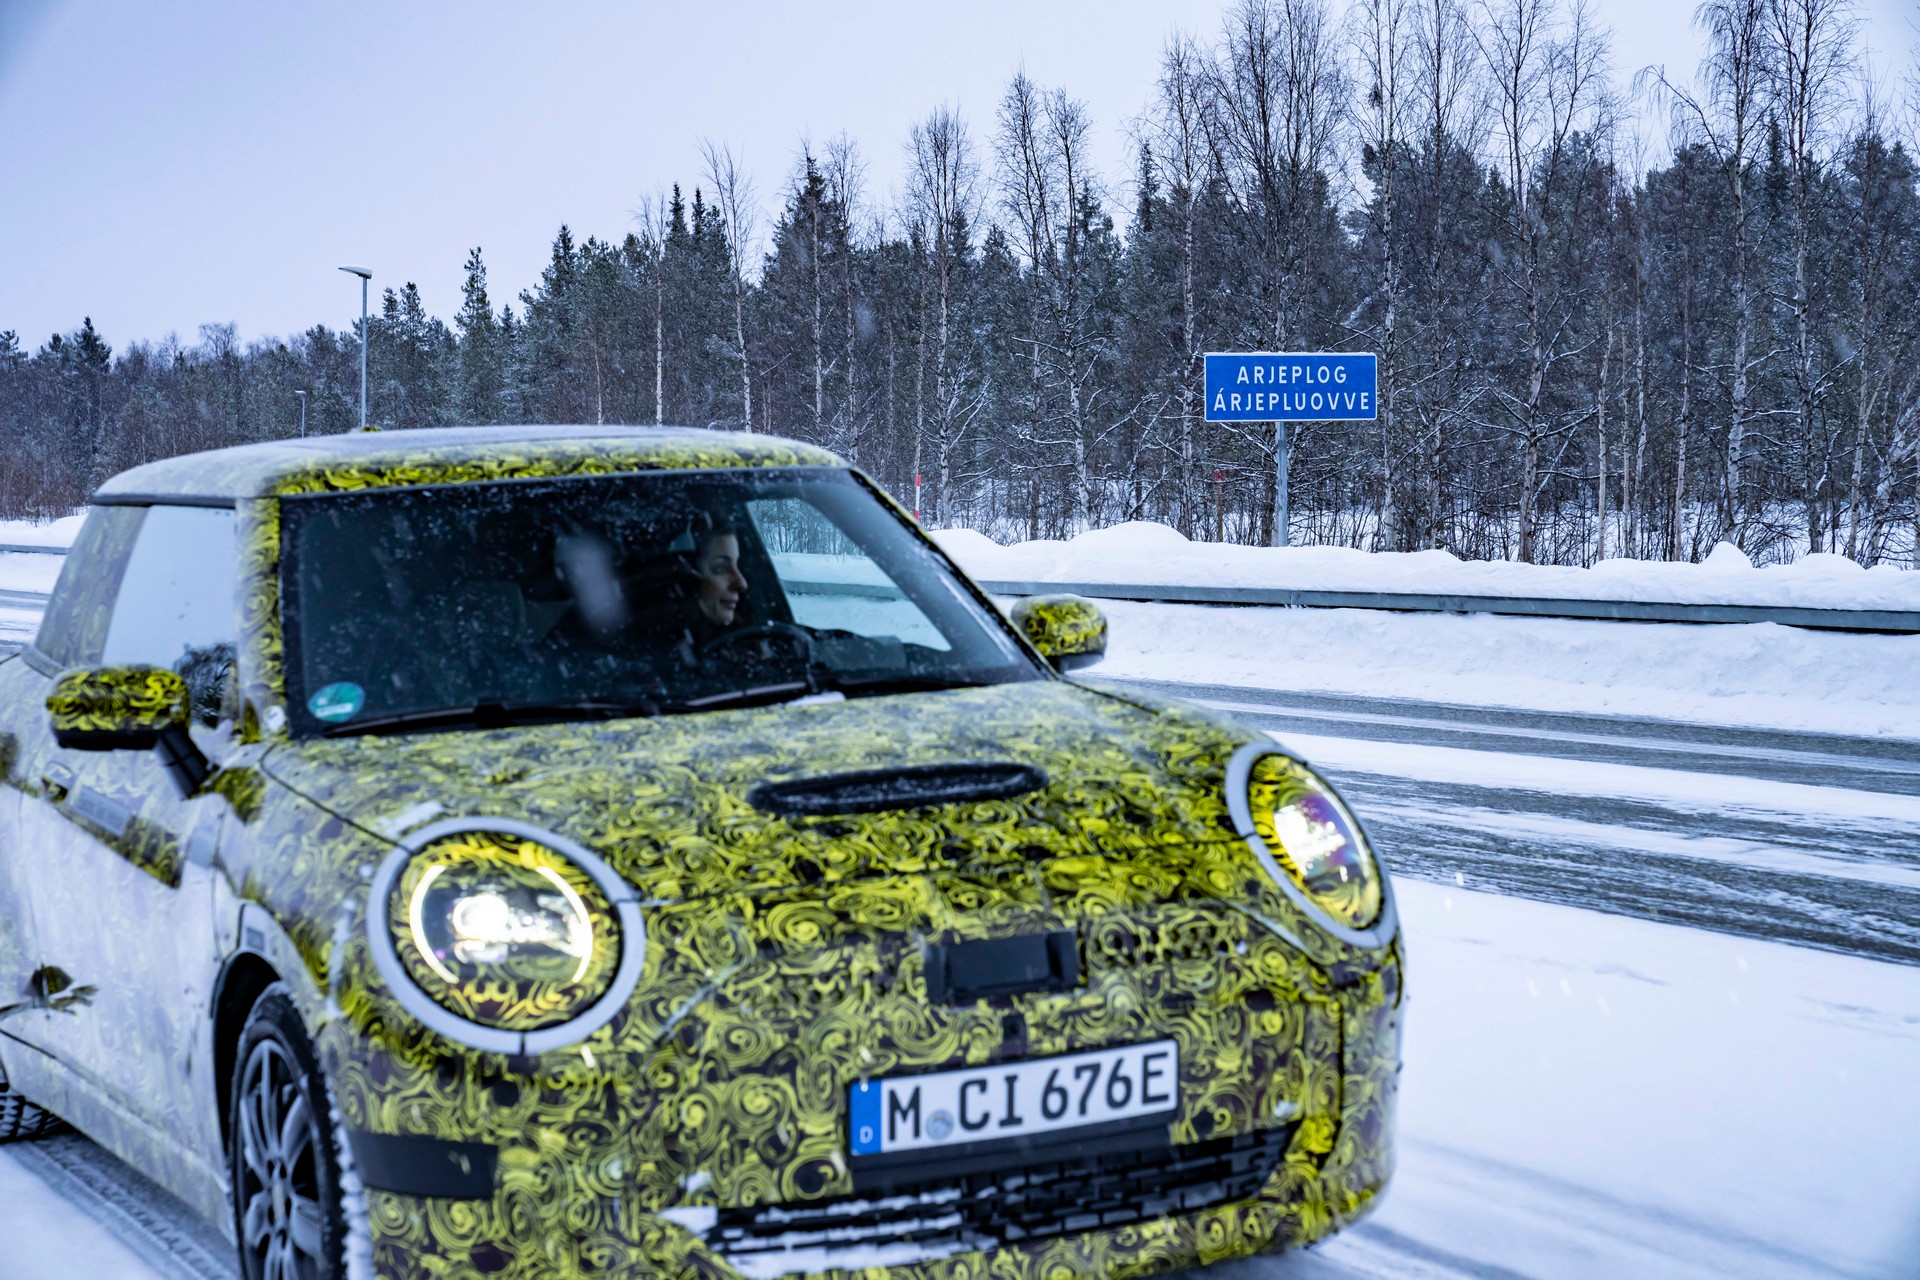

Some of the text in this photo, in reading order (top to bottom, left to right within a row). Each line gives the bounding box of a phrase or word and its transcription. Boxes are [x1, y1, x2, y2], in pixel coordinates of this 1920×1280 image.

[1236, 365, 1347, 384] ARJEPLOG
[1213, 388, 1369, 411] ÁRJEPLUOVVE
[888, 1051, 1170, 1141] M CI 676E
[859, 1126, 873, 1143] D
